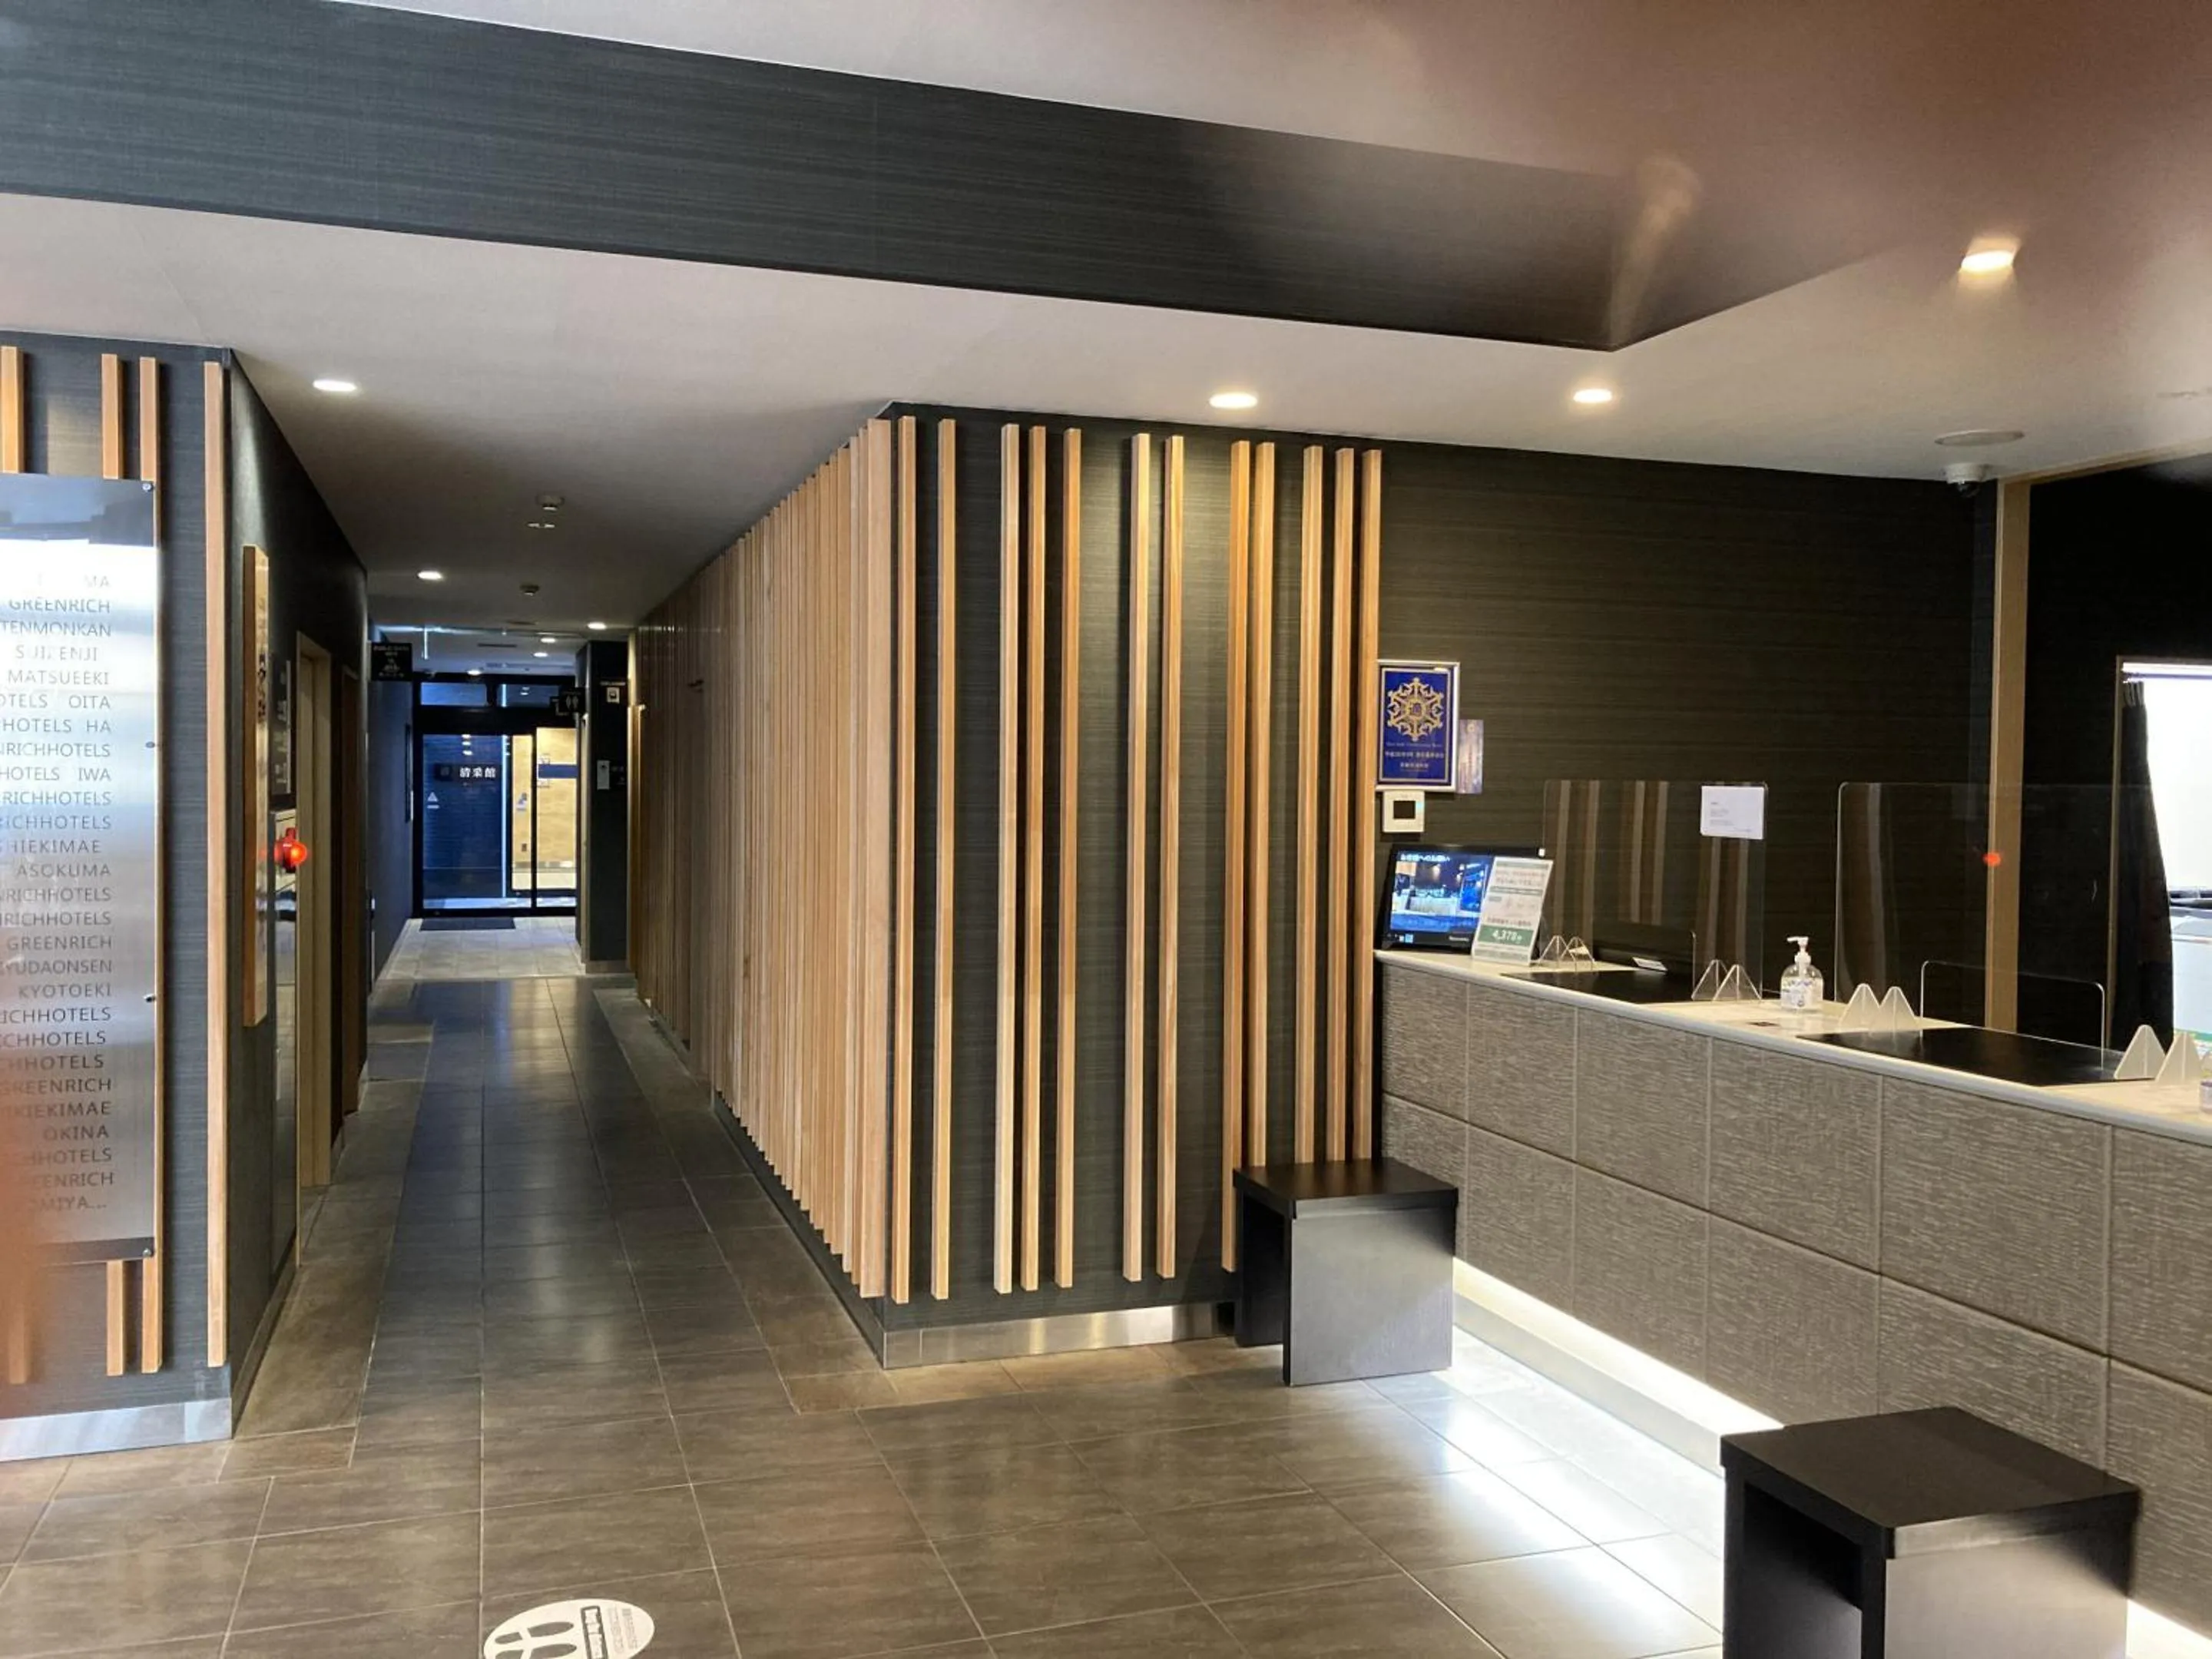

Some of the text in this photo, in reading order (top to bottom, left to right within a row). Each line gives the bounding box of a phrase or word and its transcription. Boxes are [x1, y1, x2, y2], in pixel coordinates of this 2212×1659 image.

[9, 597, 110, 613] GREENRICH
[8, 669, 109, 685] MATSUEEKI
[68, 694, 111, 708] OITA
[2, 717, 111, 733] HOTELS HA
[78, 767, 111, 781] IWA
[16, 863, 111, 877] ASOKUMA
[0, 912, 111, 926] RICHHOTELS
[7, 935, 112, 951] GREENRICH
[18, 983, 111, 998] KYOTOEKI
